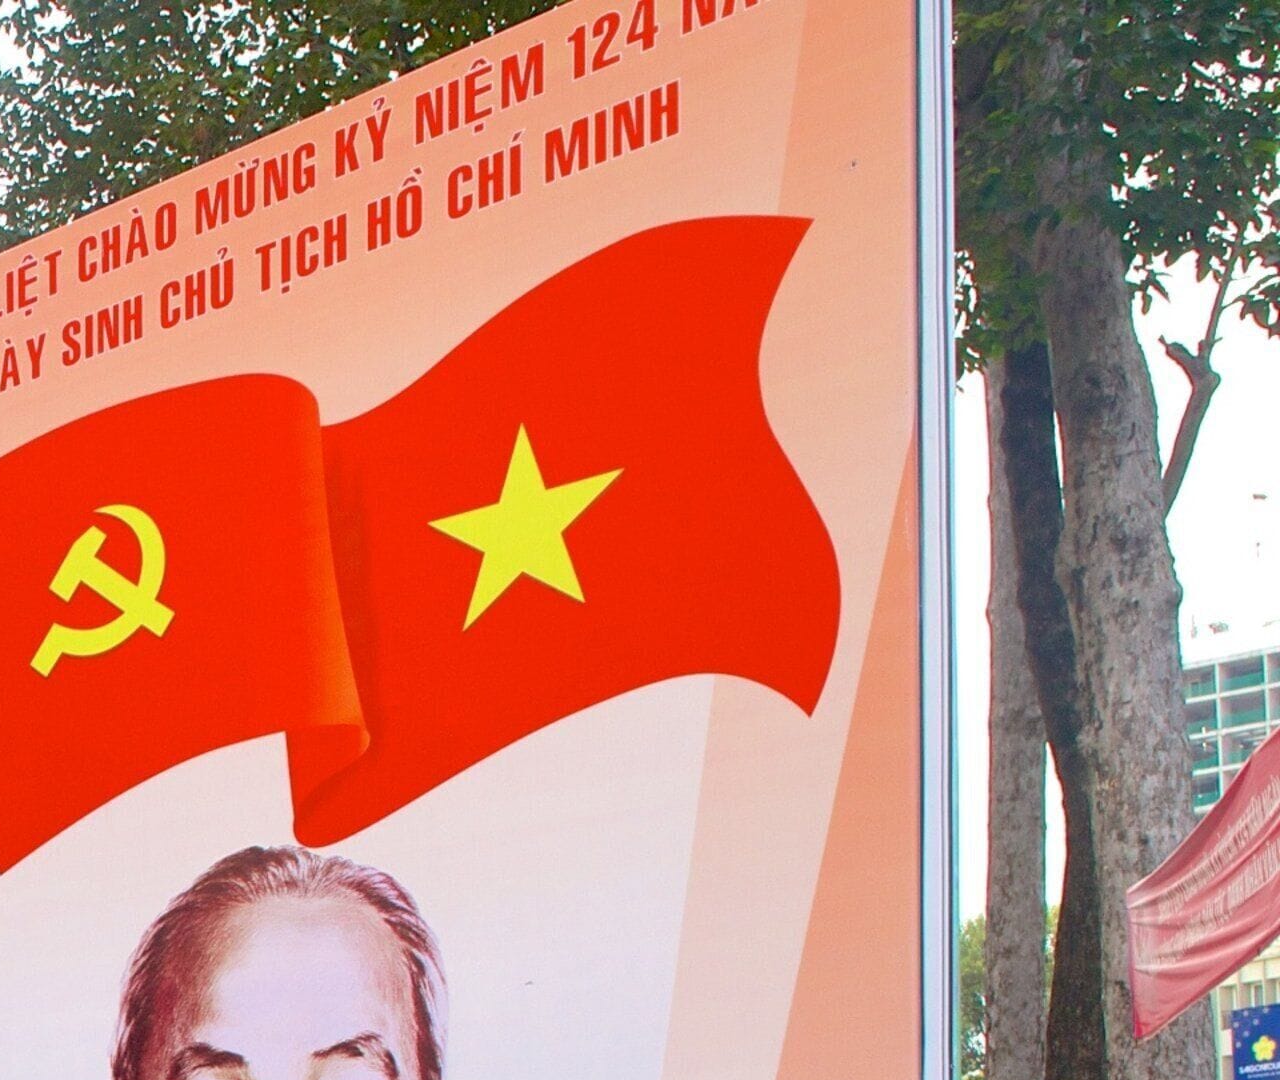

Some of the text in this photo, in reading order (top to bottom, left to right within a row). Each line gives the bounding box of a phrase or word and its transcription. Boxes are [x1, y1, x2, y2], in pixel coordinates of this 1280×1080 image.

[61, 294, 143, 367] SINH
[159, 246, 234, 330] CHỦ
[254, 213, 348, 294] TỊCH
[367, 166, 423, 252] HỒ
[447, 132, 522, 220] CHÍ
[544, 81, 680, 184] MINH
[77, 201, 177, 283] CHÀO
[195, 142, 316, 236] MỪNG
[334, 97, 392, 179] KỶ
[415, 42, 545, 145] NIỆM
[567, 0, 659, 80] 124
